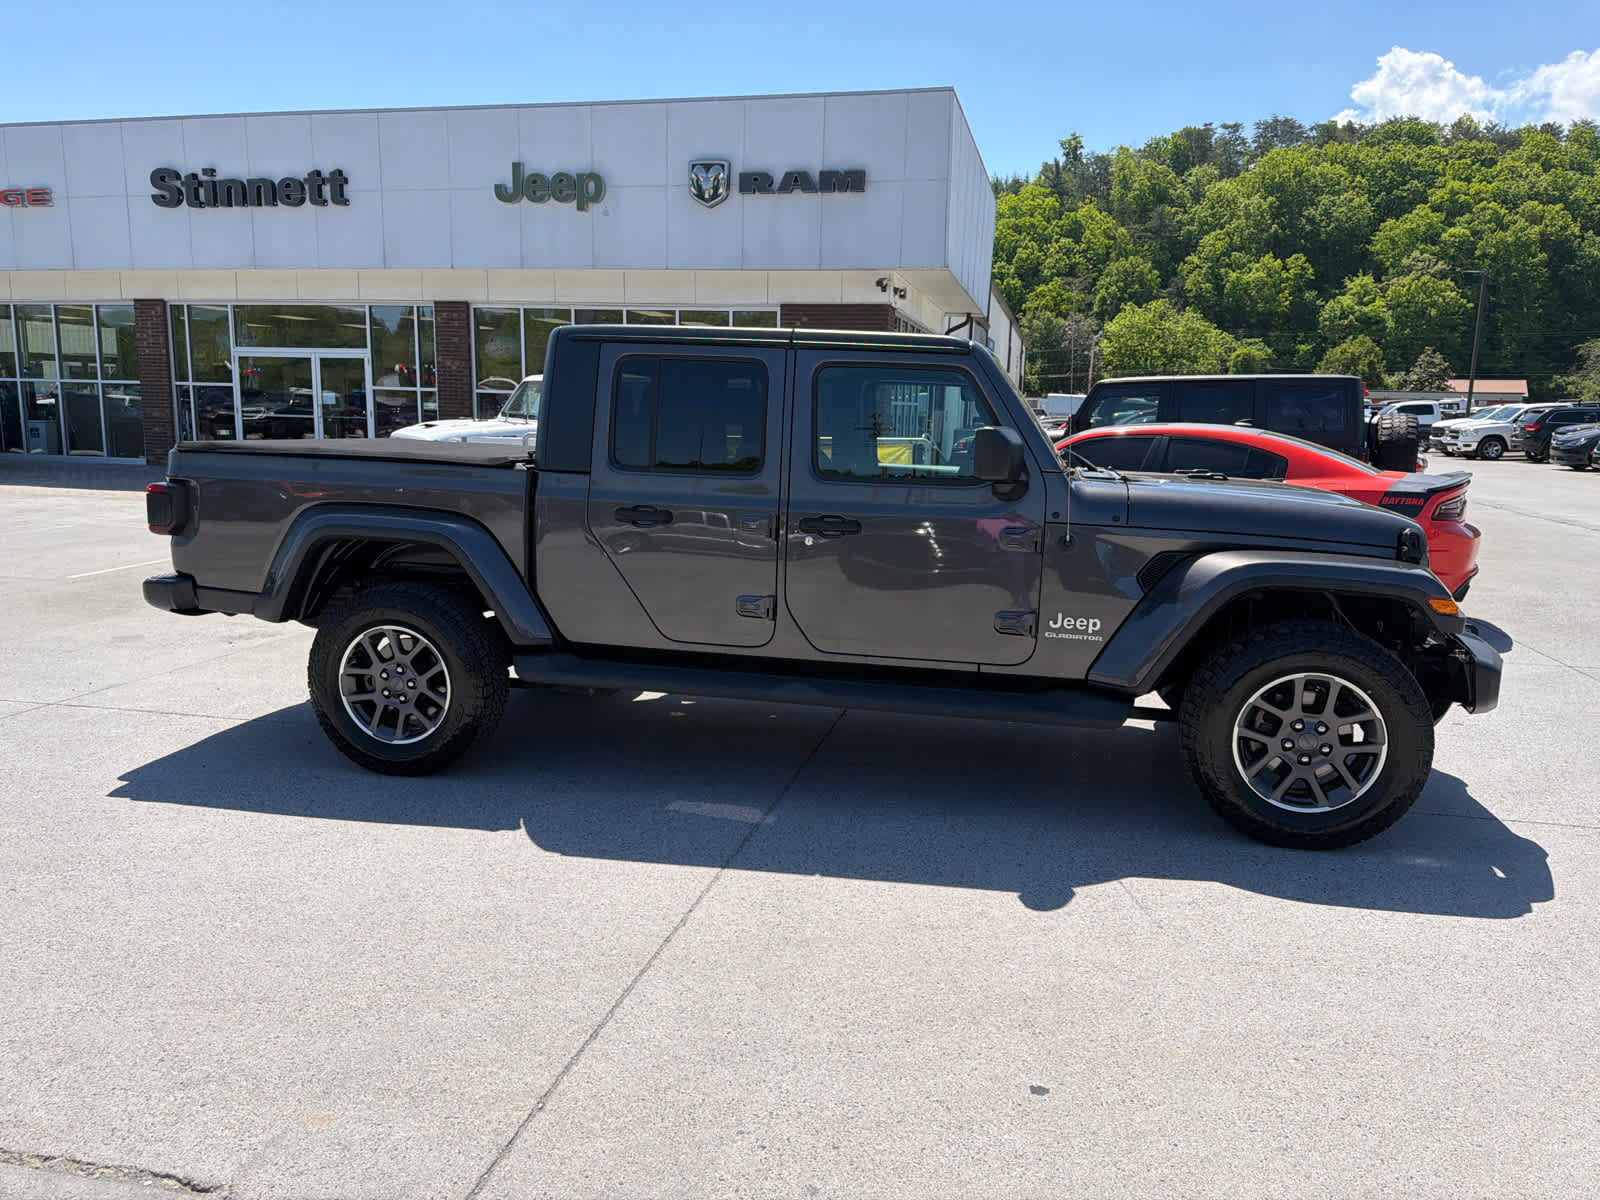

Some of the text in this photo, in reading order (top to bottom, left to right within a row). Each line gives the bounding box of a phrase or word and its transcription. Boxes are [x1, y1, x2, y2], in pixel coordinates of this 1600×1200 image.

[150, 167, 350, 208] Stinnett
[494, 162, 605, 212] Jeep
[738, 170, 866, 194] RAM
[0, 188, 51, 207] GE
[1382, 496, 1424, 505] DAYTONA
[1049, 612, 1101, 633] Jeep
[1044, 631, 1104, 641] GLADIATOR
